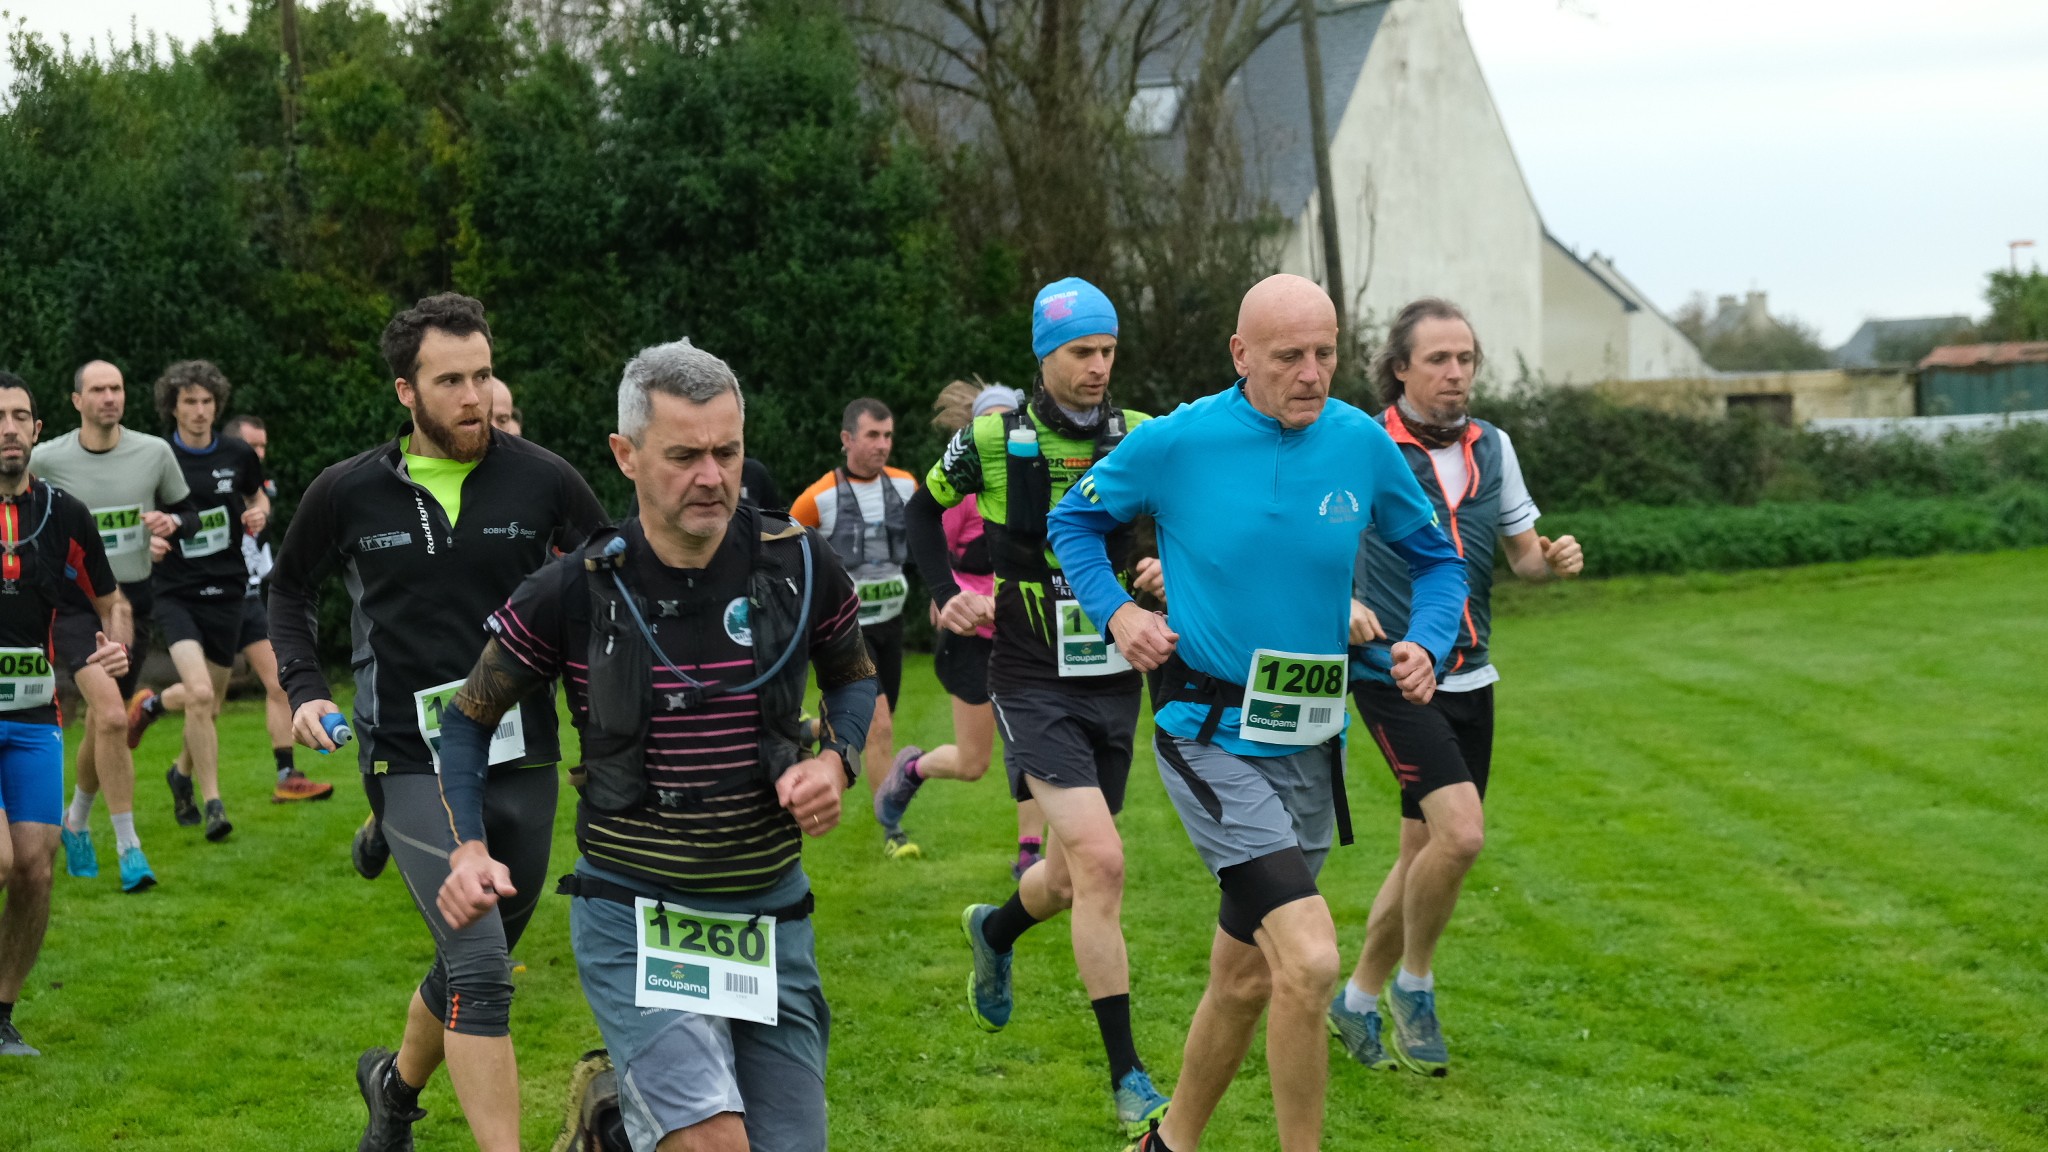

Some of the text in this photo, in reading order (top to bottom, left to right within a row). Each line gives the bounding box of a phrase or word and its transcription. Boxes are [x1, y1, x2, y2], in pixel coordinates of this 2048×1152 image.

[1040, 290, 1079, 307] TRIATHLON
[1065, 653, 1107, 663] Groupama
[1261, 660, 1343, 695] 1208
[1248, 713, 1297, 728] Groupama
[649, 914, 766, 962] 1260
[647, 974, 708, 995] Groupama
